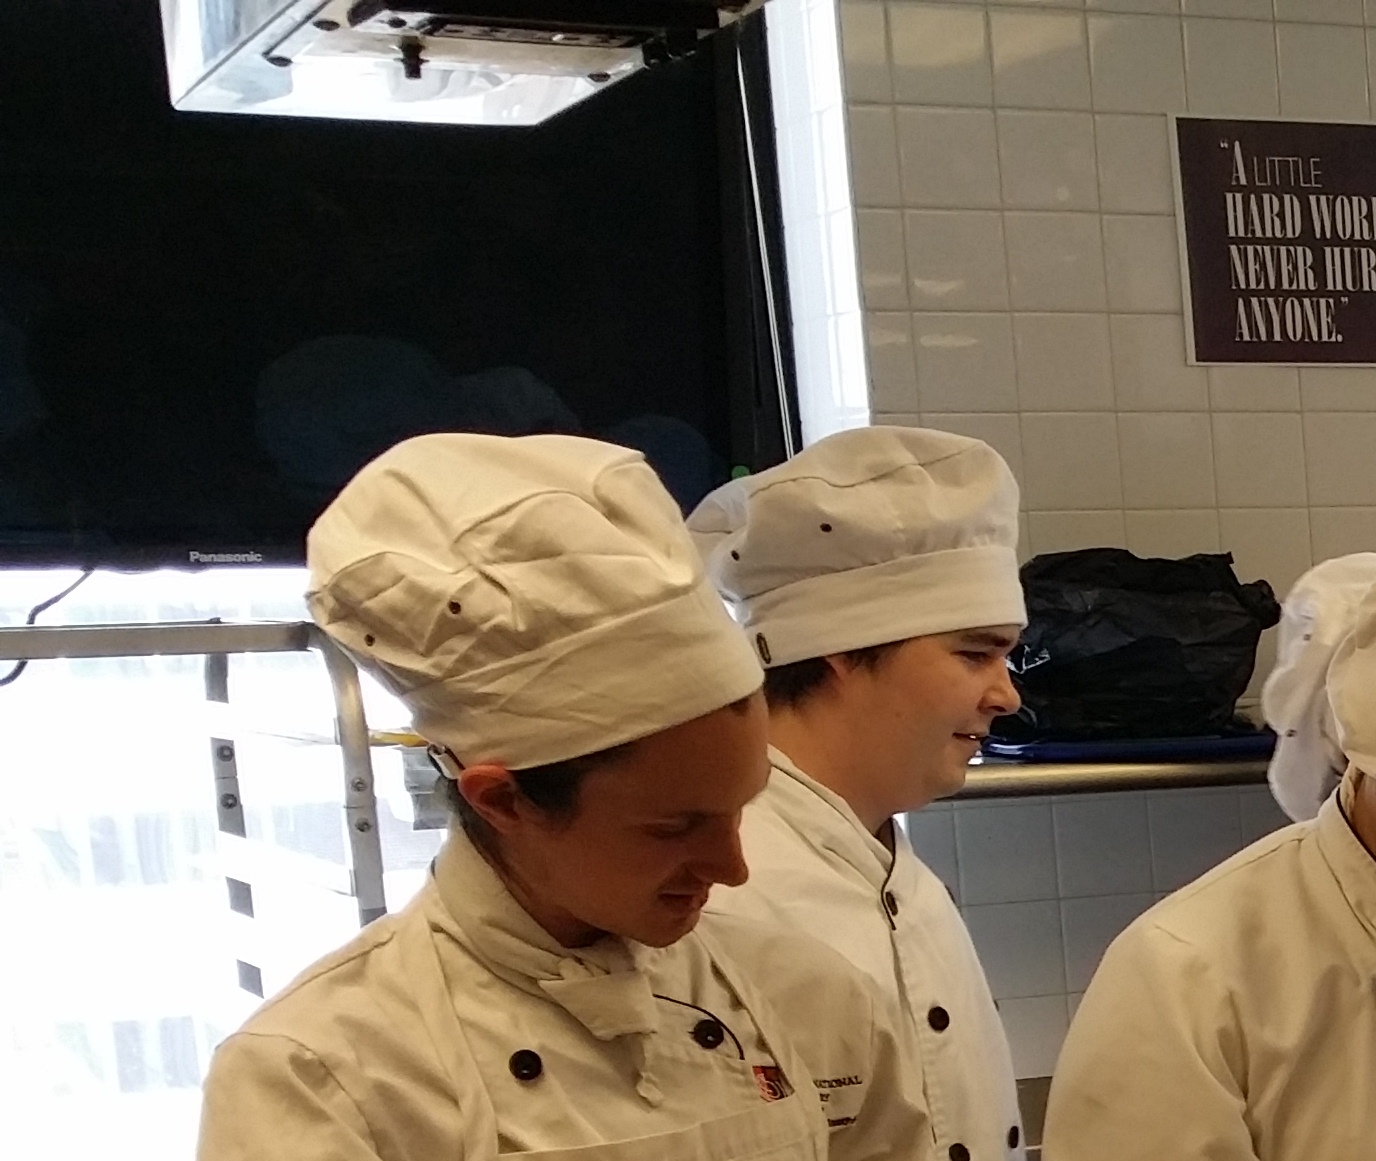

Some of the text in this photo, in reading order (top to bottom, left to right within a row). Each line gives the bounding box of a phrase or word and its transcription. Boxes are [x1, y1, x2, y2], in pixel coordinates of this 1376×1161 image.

[1253, 156, 1323, 188] LITTLE
[1225, 192, 1302, 238] HARD
[1228, 244, 1317, 291] NEVER
[189, 551, 262, 563] Panasonic
